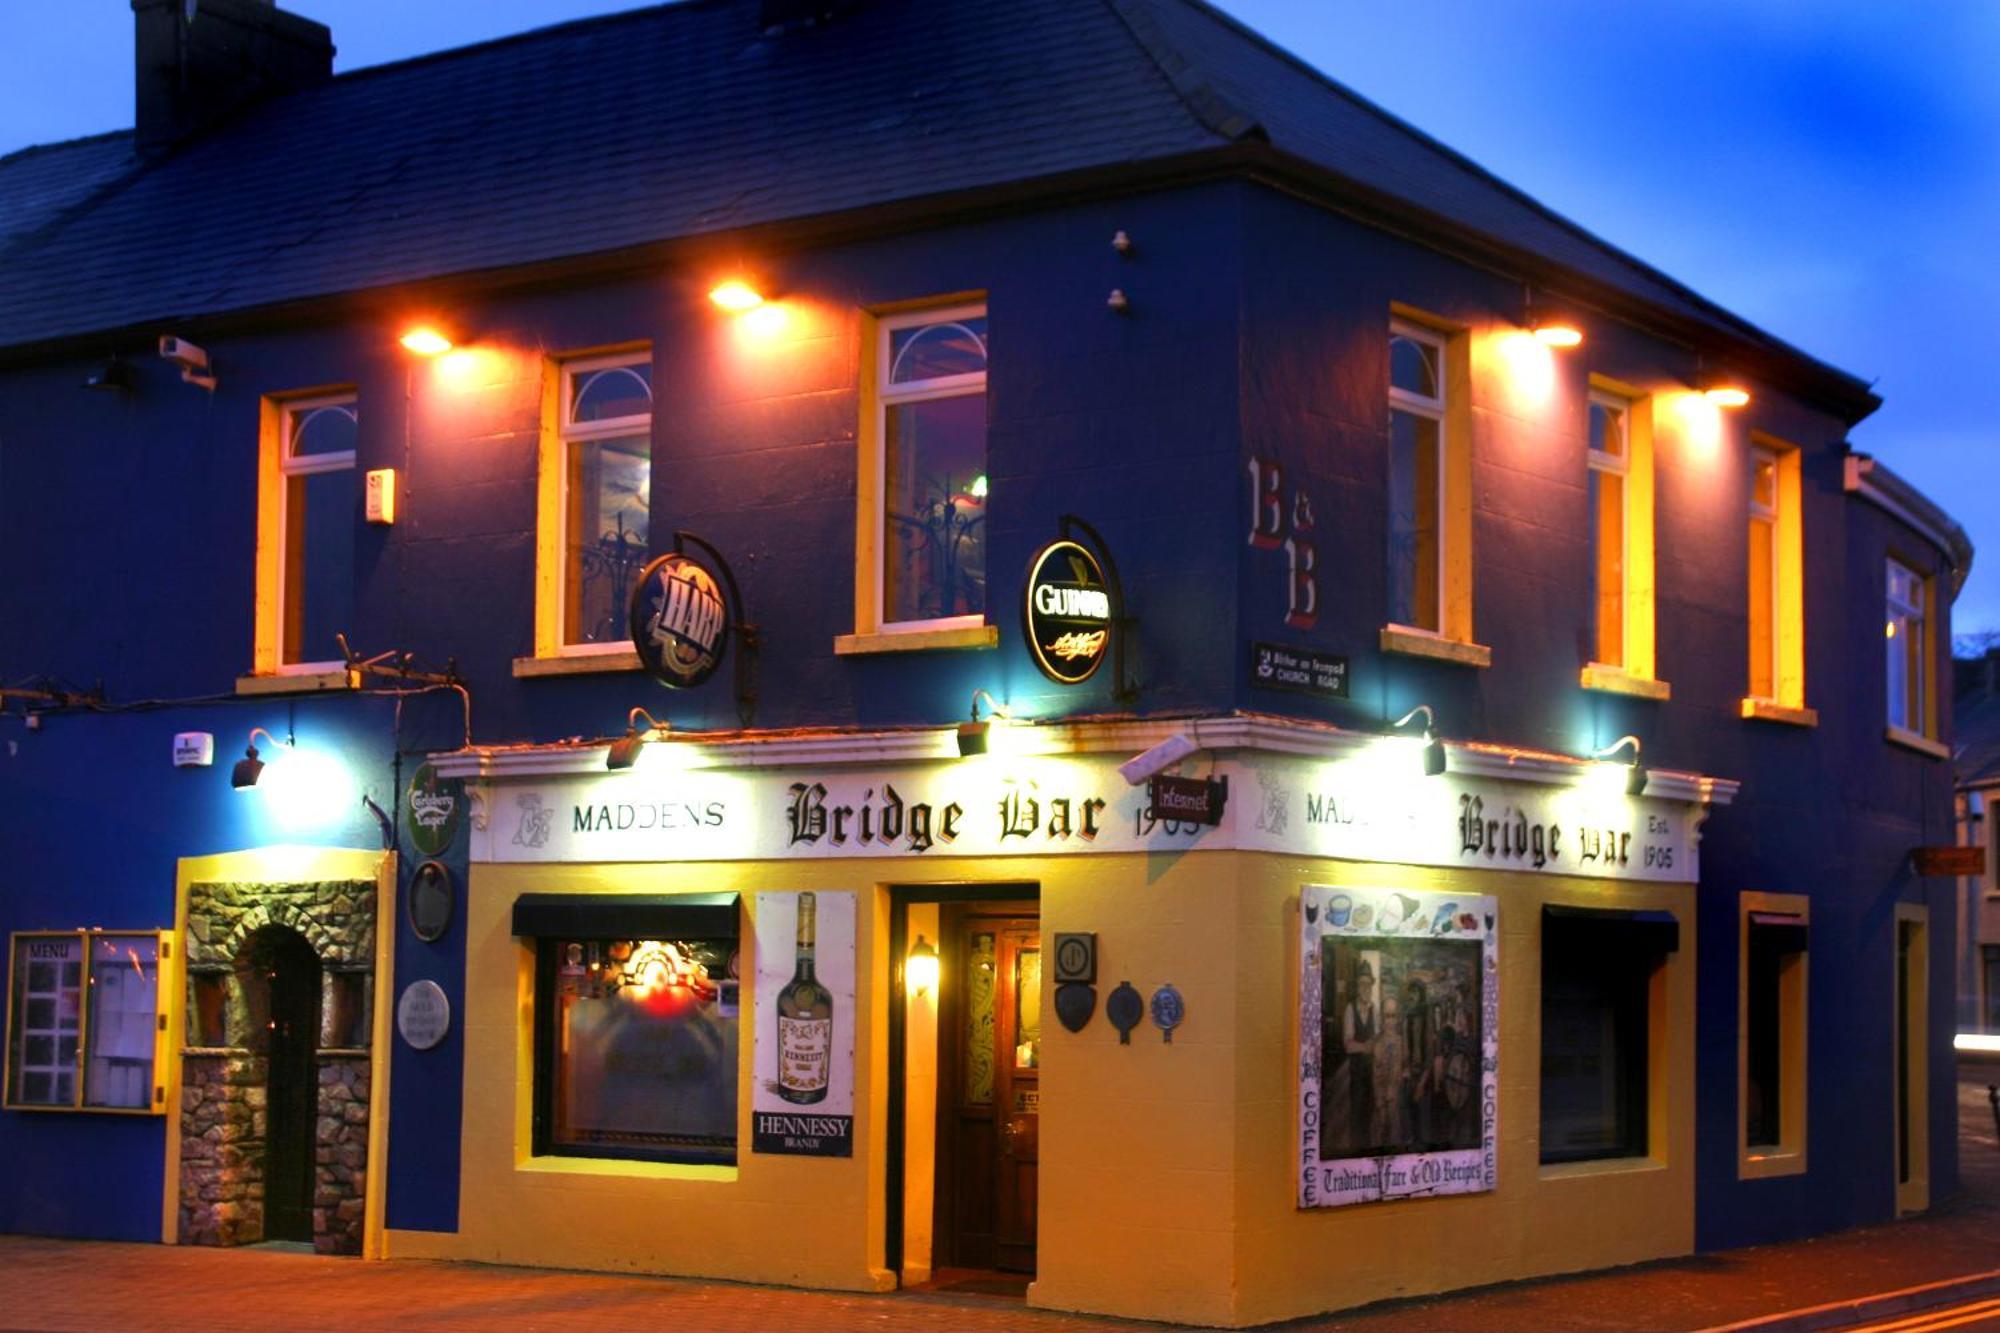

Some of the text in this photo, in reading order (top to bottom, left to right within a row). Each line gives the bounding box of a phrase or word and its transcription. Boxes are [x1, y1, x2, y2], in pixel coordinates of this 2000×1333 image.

[1278, 669, 1339, 690] CHURCH ROAD
[1157, 784, 1209, 812] Internet
[571, 778, 1107, 854] MADDENS Bridge Bar
[1458, 792, 1562, 869] Bridge
[29, 942, 69, 959] MENU
[758, 1114, 849, 1138] HENNESSY
[1483, 1084, 1496, 1186] COFFEE
[784, 1136, 821, 1150] BRANDY
[1303, 1091, 1317, 1203] COFFEE
